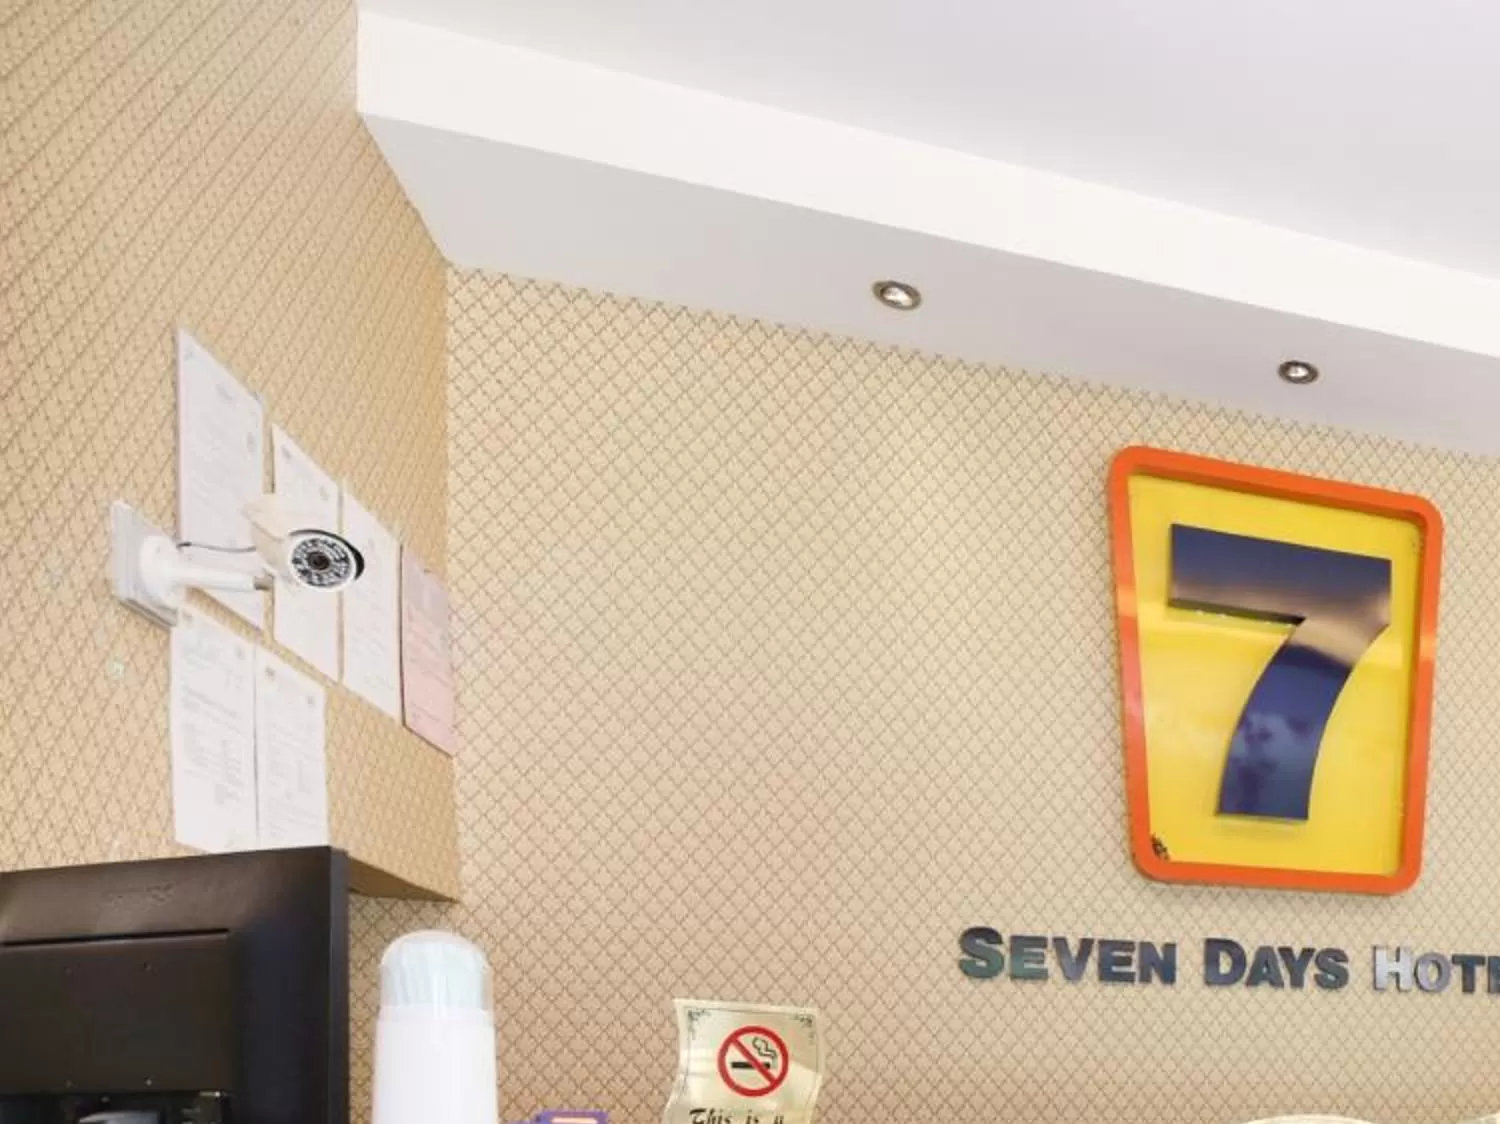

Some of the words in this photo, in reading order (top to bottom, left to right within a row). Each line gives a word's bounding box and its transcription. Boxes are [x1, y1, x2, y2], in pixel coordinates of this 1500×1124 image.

[1168, 523, 1392, 821] 7
[958, 926, 1177, 984] SEVEN
[1204, 937, 1349, 990] DAYS
